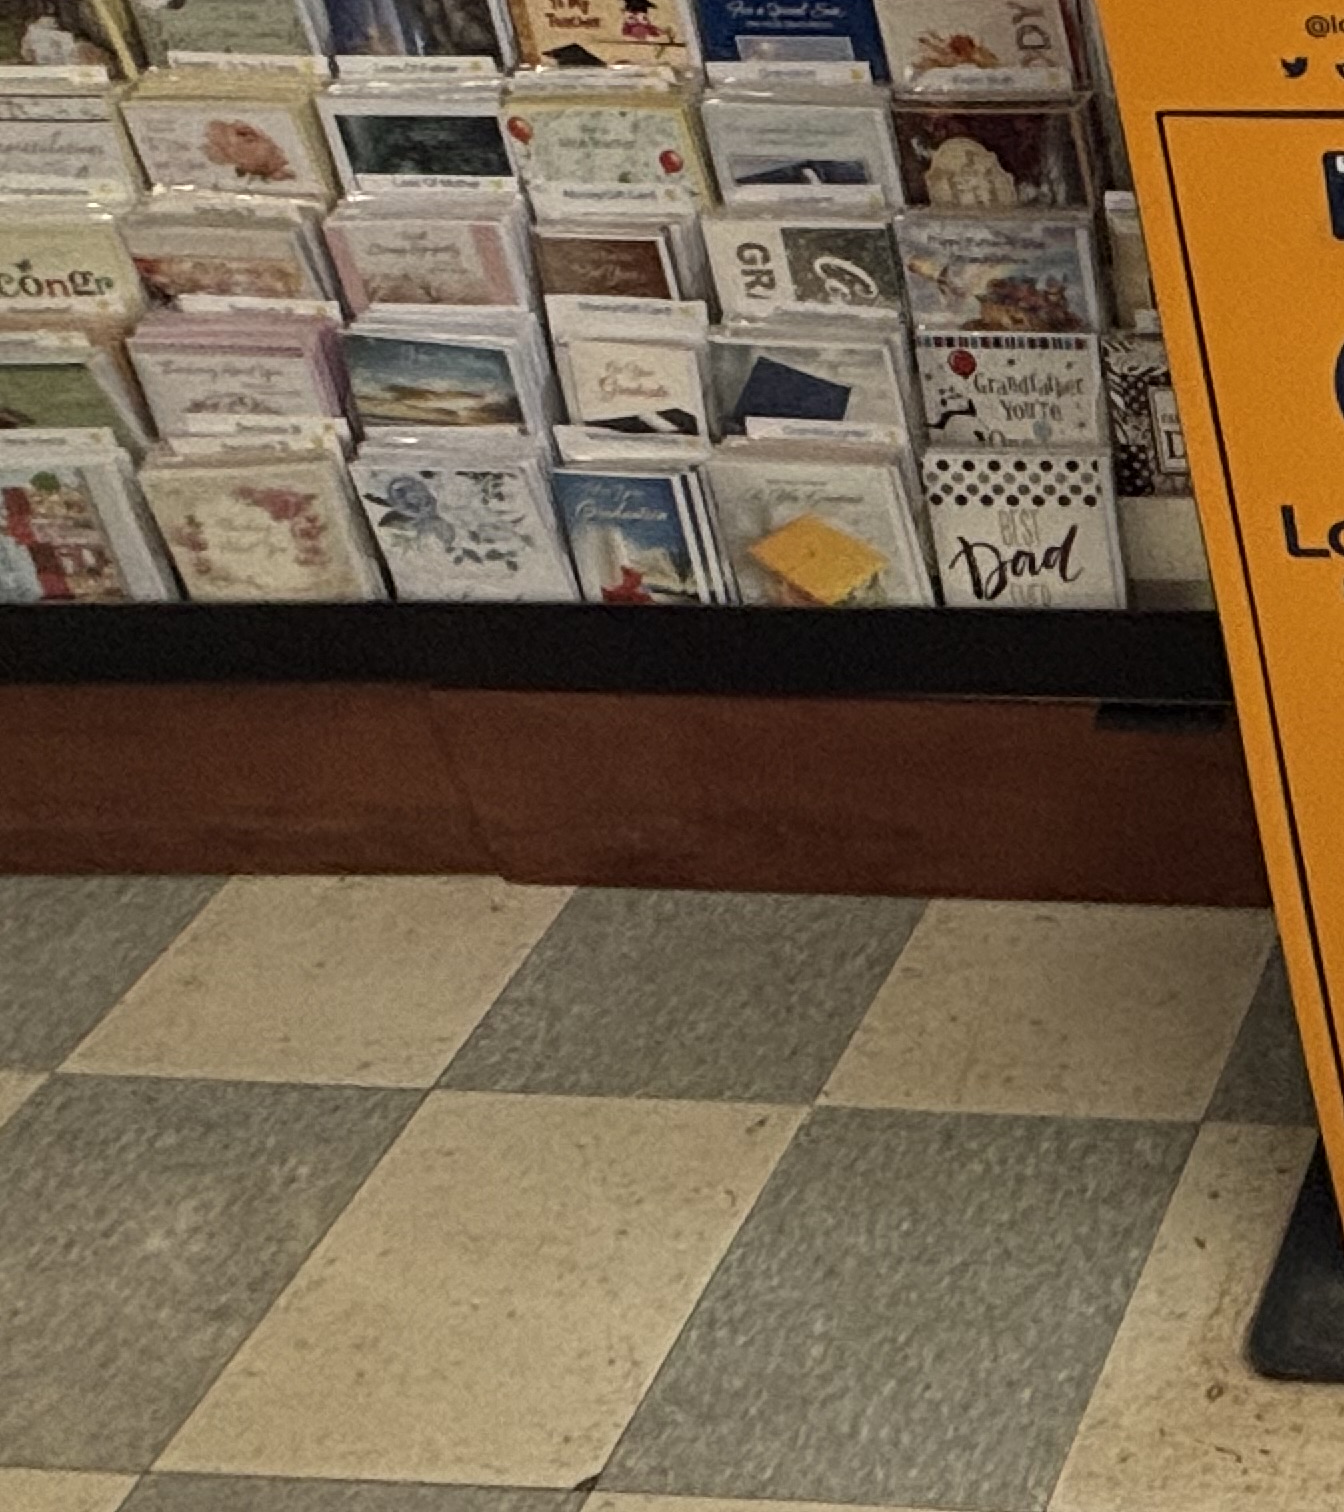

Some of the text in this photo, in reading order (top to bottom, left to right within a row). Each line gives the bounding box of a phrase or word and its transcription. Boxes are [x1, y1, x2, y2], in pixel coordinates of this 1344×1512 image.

[973, 372, 1084, 400] Grandfather
[999, 397, 1063, 423] You're
[949, 524, 1084, 601] Dad
